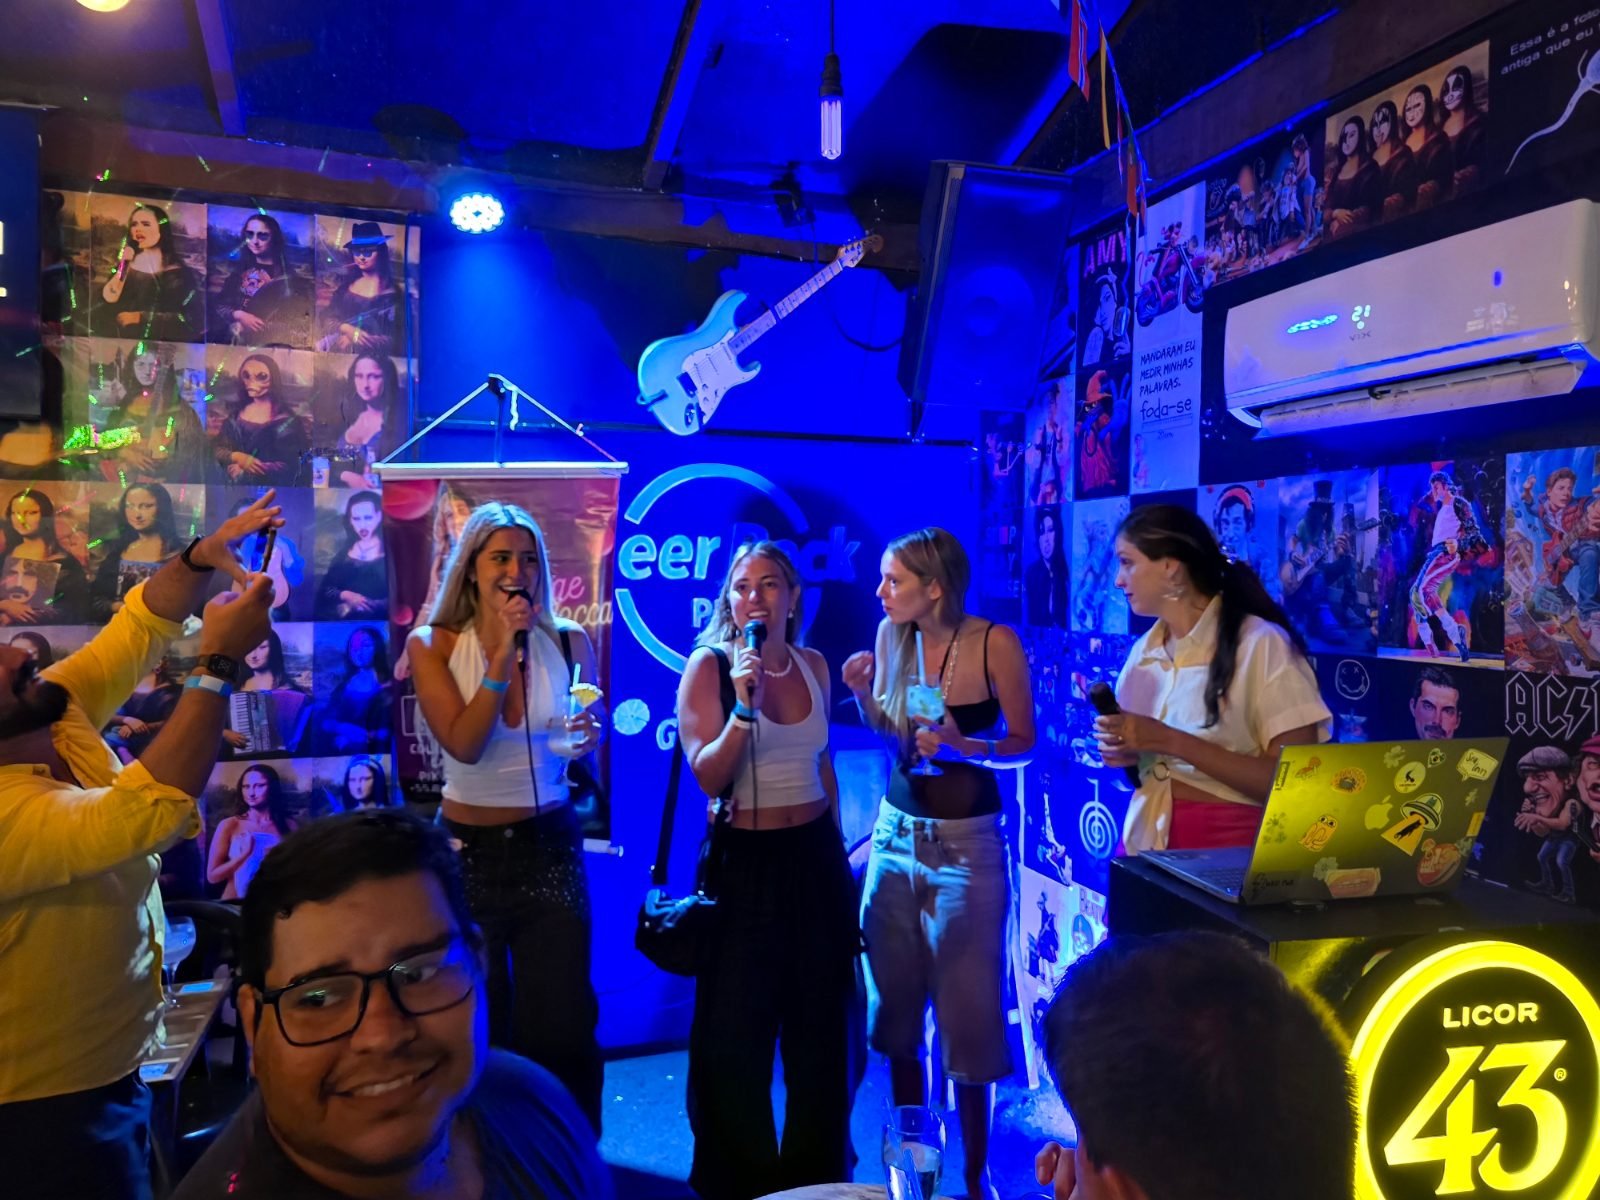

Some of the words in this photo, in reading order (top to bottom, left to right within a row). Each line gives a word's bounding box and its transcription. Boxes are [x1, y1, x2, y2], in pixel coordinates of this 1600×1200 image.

[1501, 51, 1540, 74] antiga
[1545, 38, 1571, 55] que
[1575, 27, 1594, 41] eu
[1510, 35, 1542, 56] Essa
[1560, 23, 1569, 32] a
[1084, 231, 1127, 277] AMY
[1140, 344, 1183, 366] MANDARAM
[1184, 339, 1196, 353] EU
[1140, 365, 1162, 381] MEDIR
[1163, 356, 1194, 376] MINHAS
[1139, 377, 1181, 397] PALAVRAS.
[1140, 398, 1192, 422] foda-se
[618, 534, 721, 581] eer
[1443, 1002, 1539, 1028] LICOR
[1384, 1039, 1568, 1195] 43
